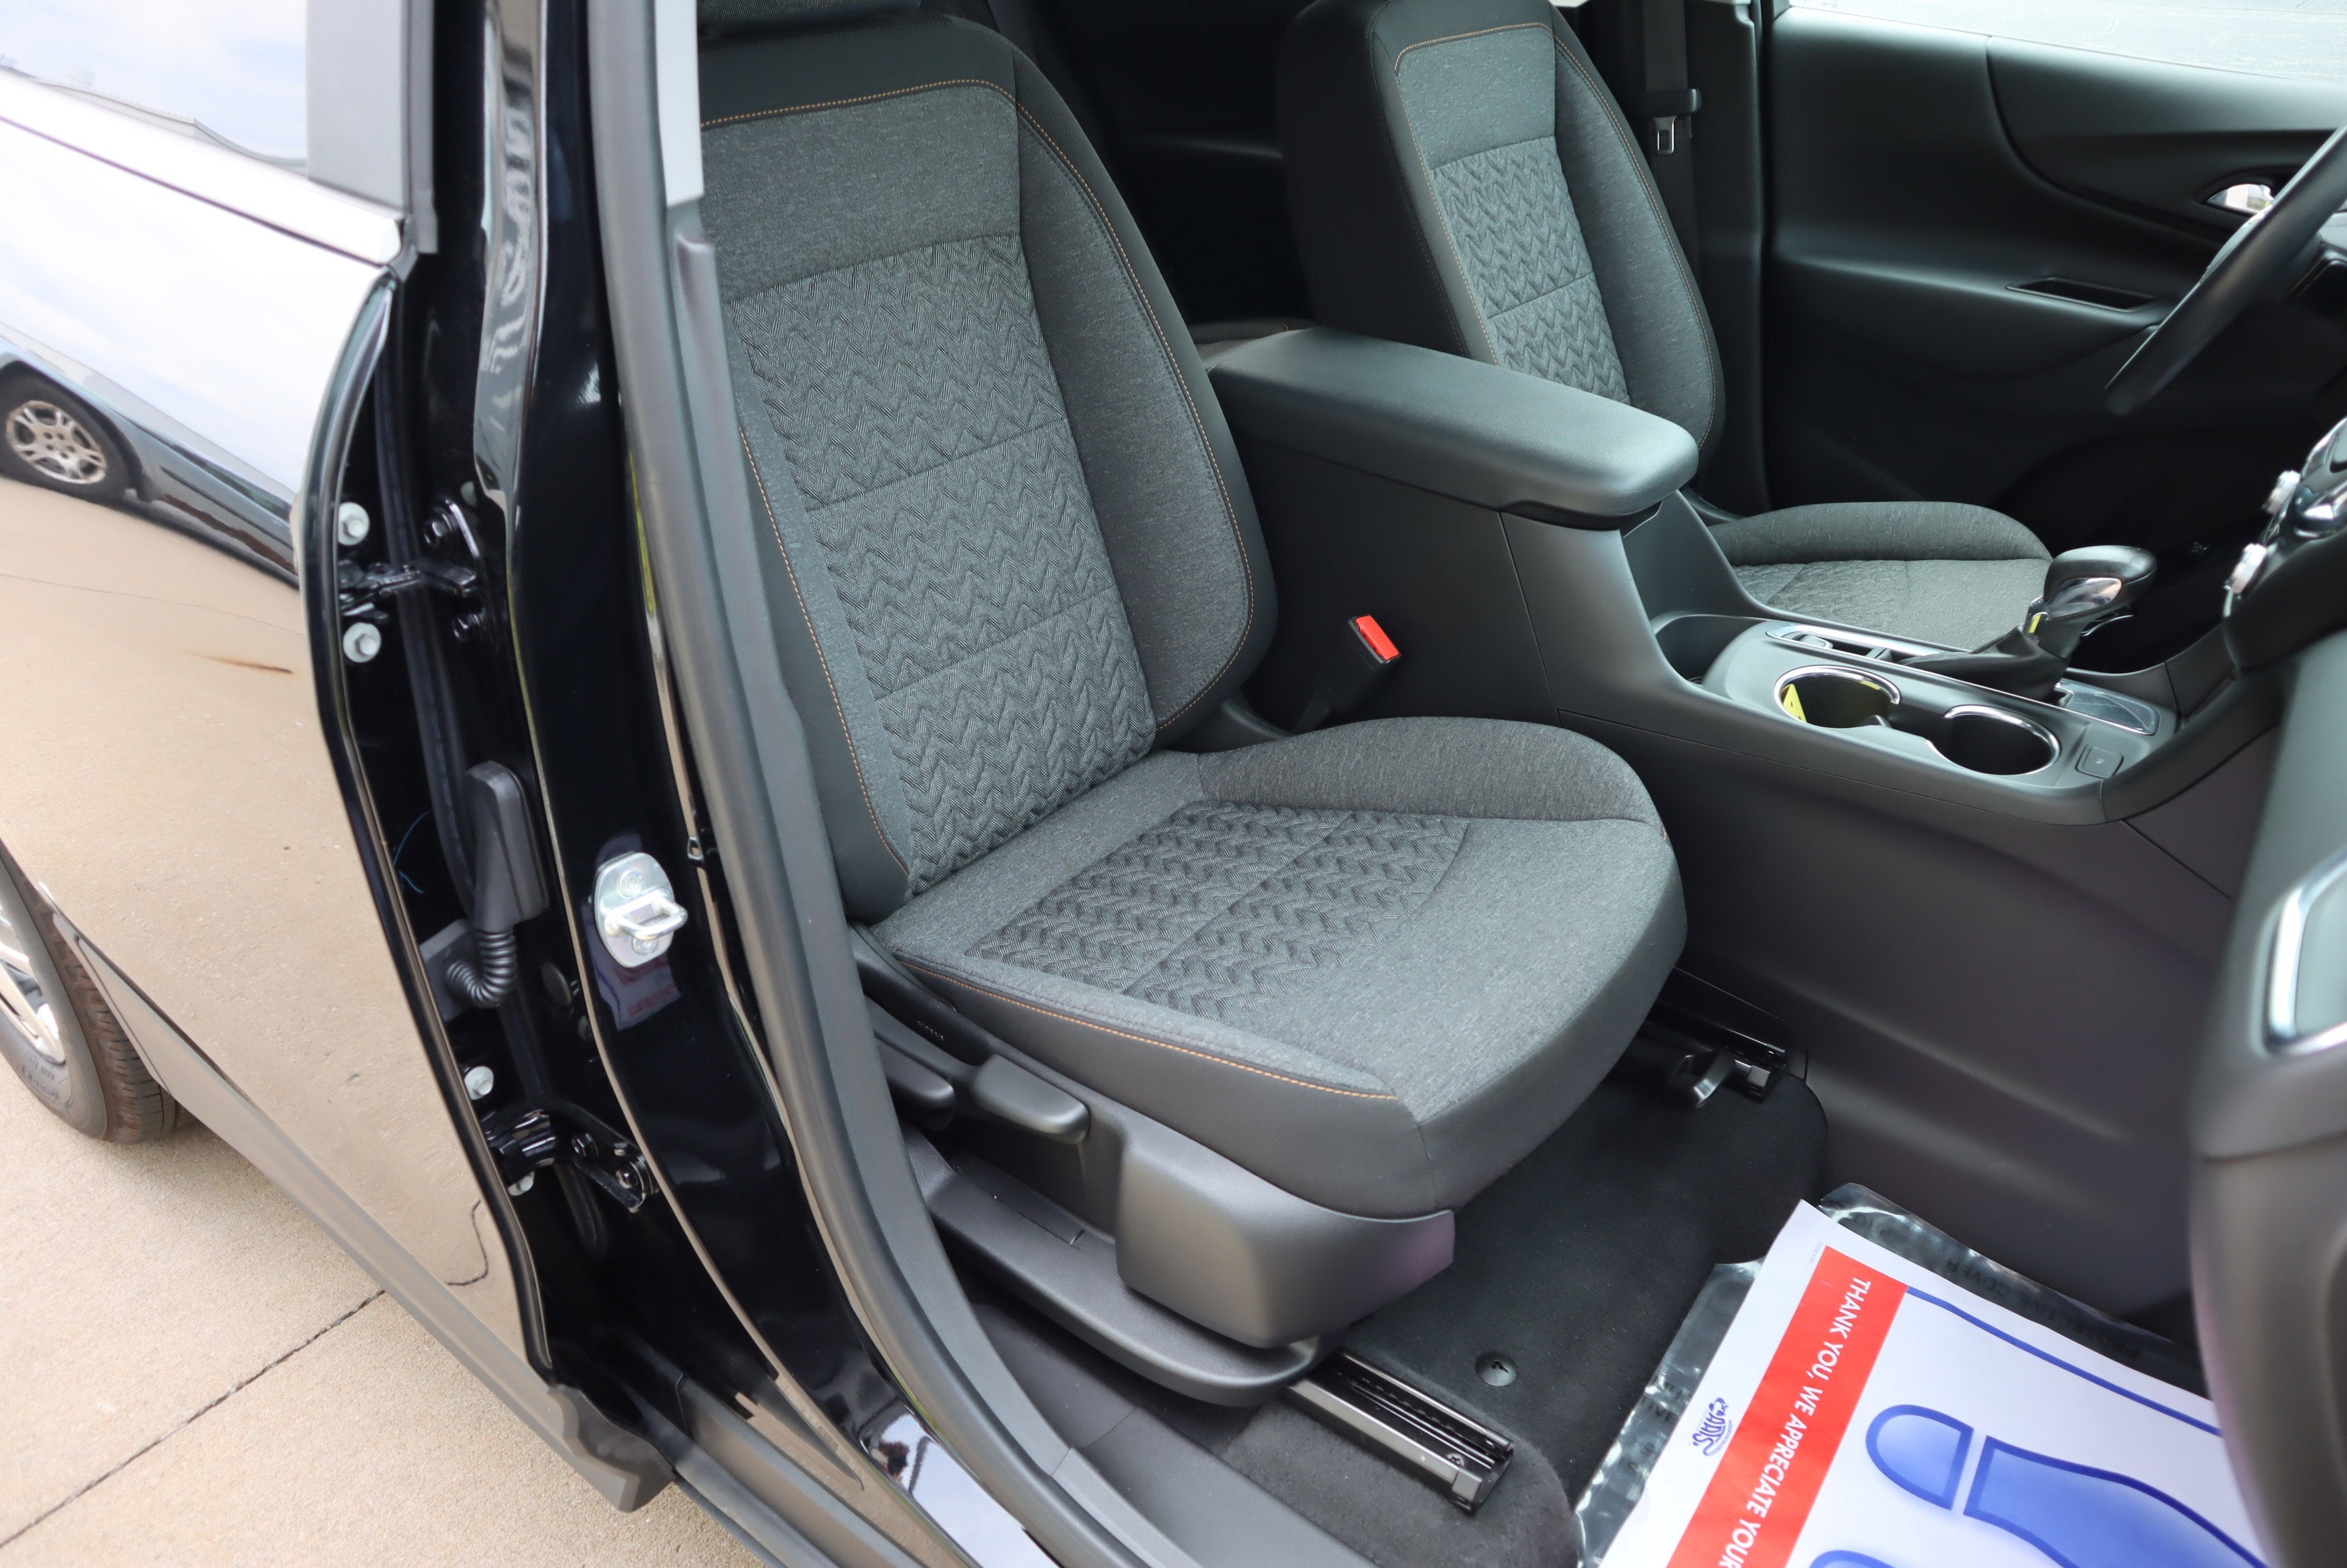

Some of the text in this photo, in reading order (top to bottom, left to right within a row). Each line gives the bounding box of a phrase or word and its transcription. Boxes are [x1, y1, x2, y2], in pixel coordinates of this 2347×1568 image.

[1719, 1277, 1872, 1568] THANK YOU, WE APPRECIATE YOUR
